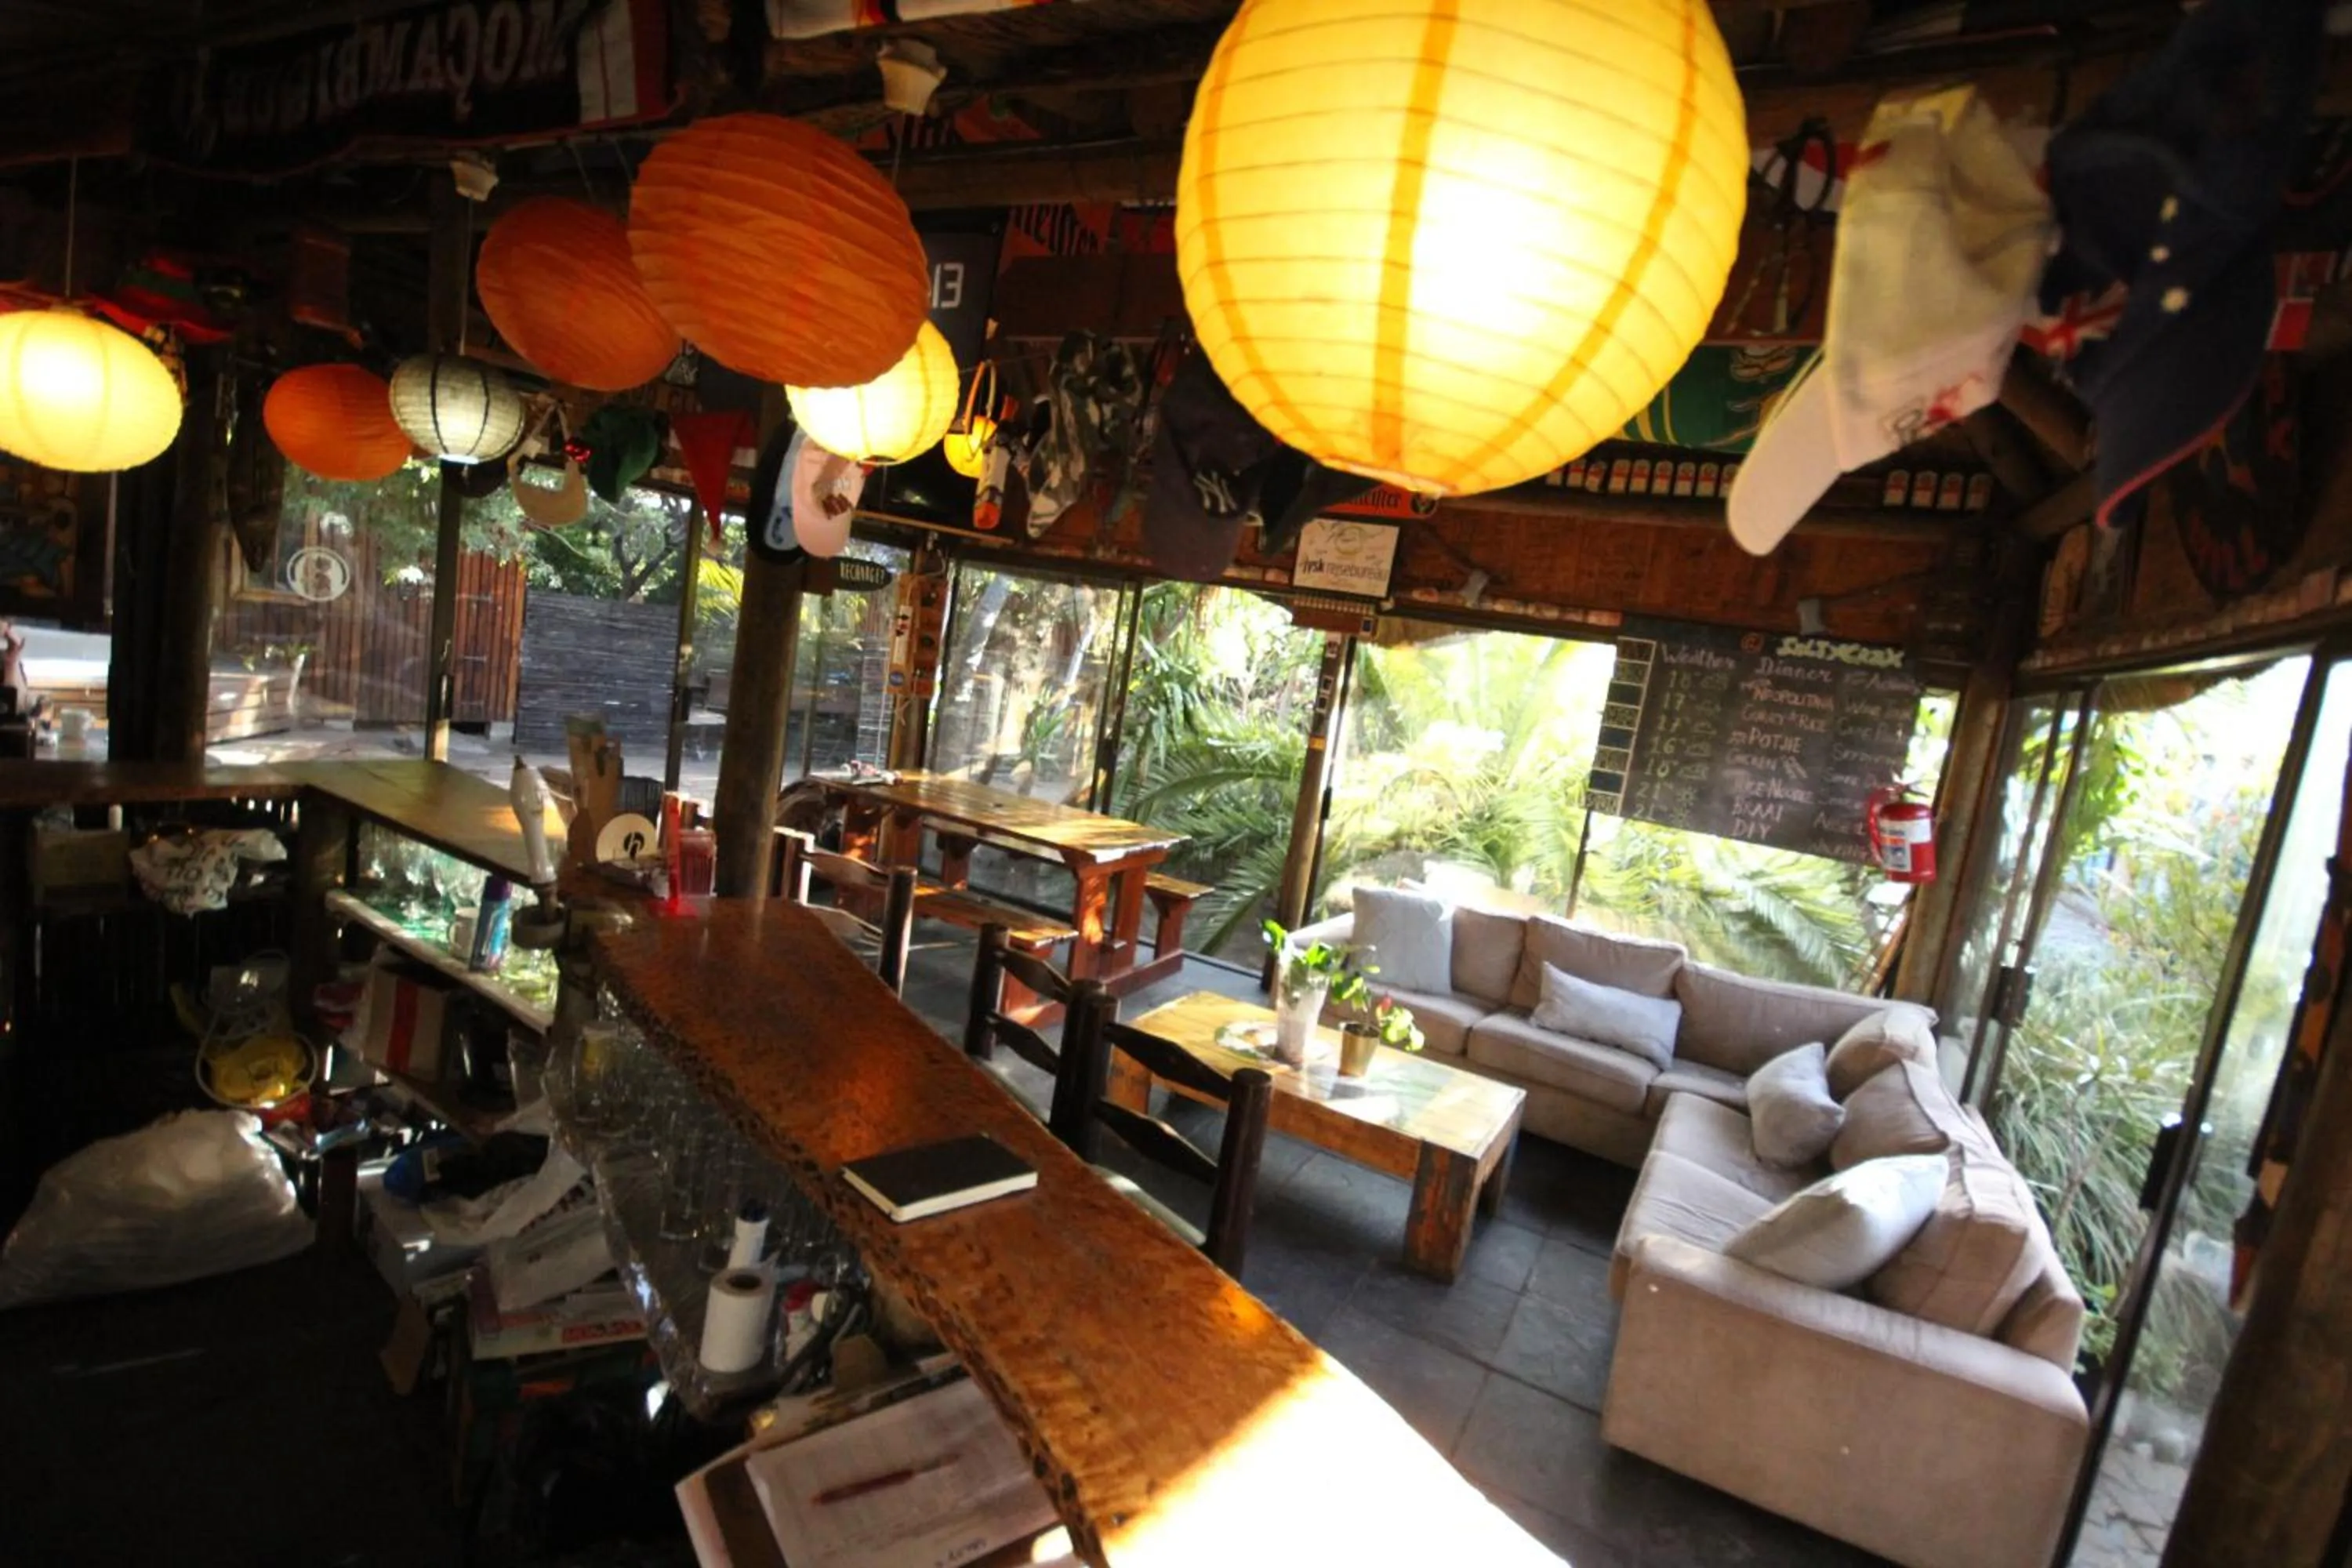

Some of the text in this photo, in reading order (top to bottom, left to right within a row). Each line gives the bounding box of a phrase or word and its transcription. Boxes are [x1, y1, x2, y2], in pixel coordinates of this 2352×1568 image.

[1661, 642, 1736, 670] Weather
[1755, 655, 1832, 684] Dinner
[1730, 818, 1772, 840] DIY
